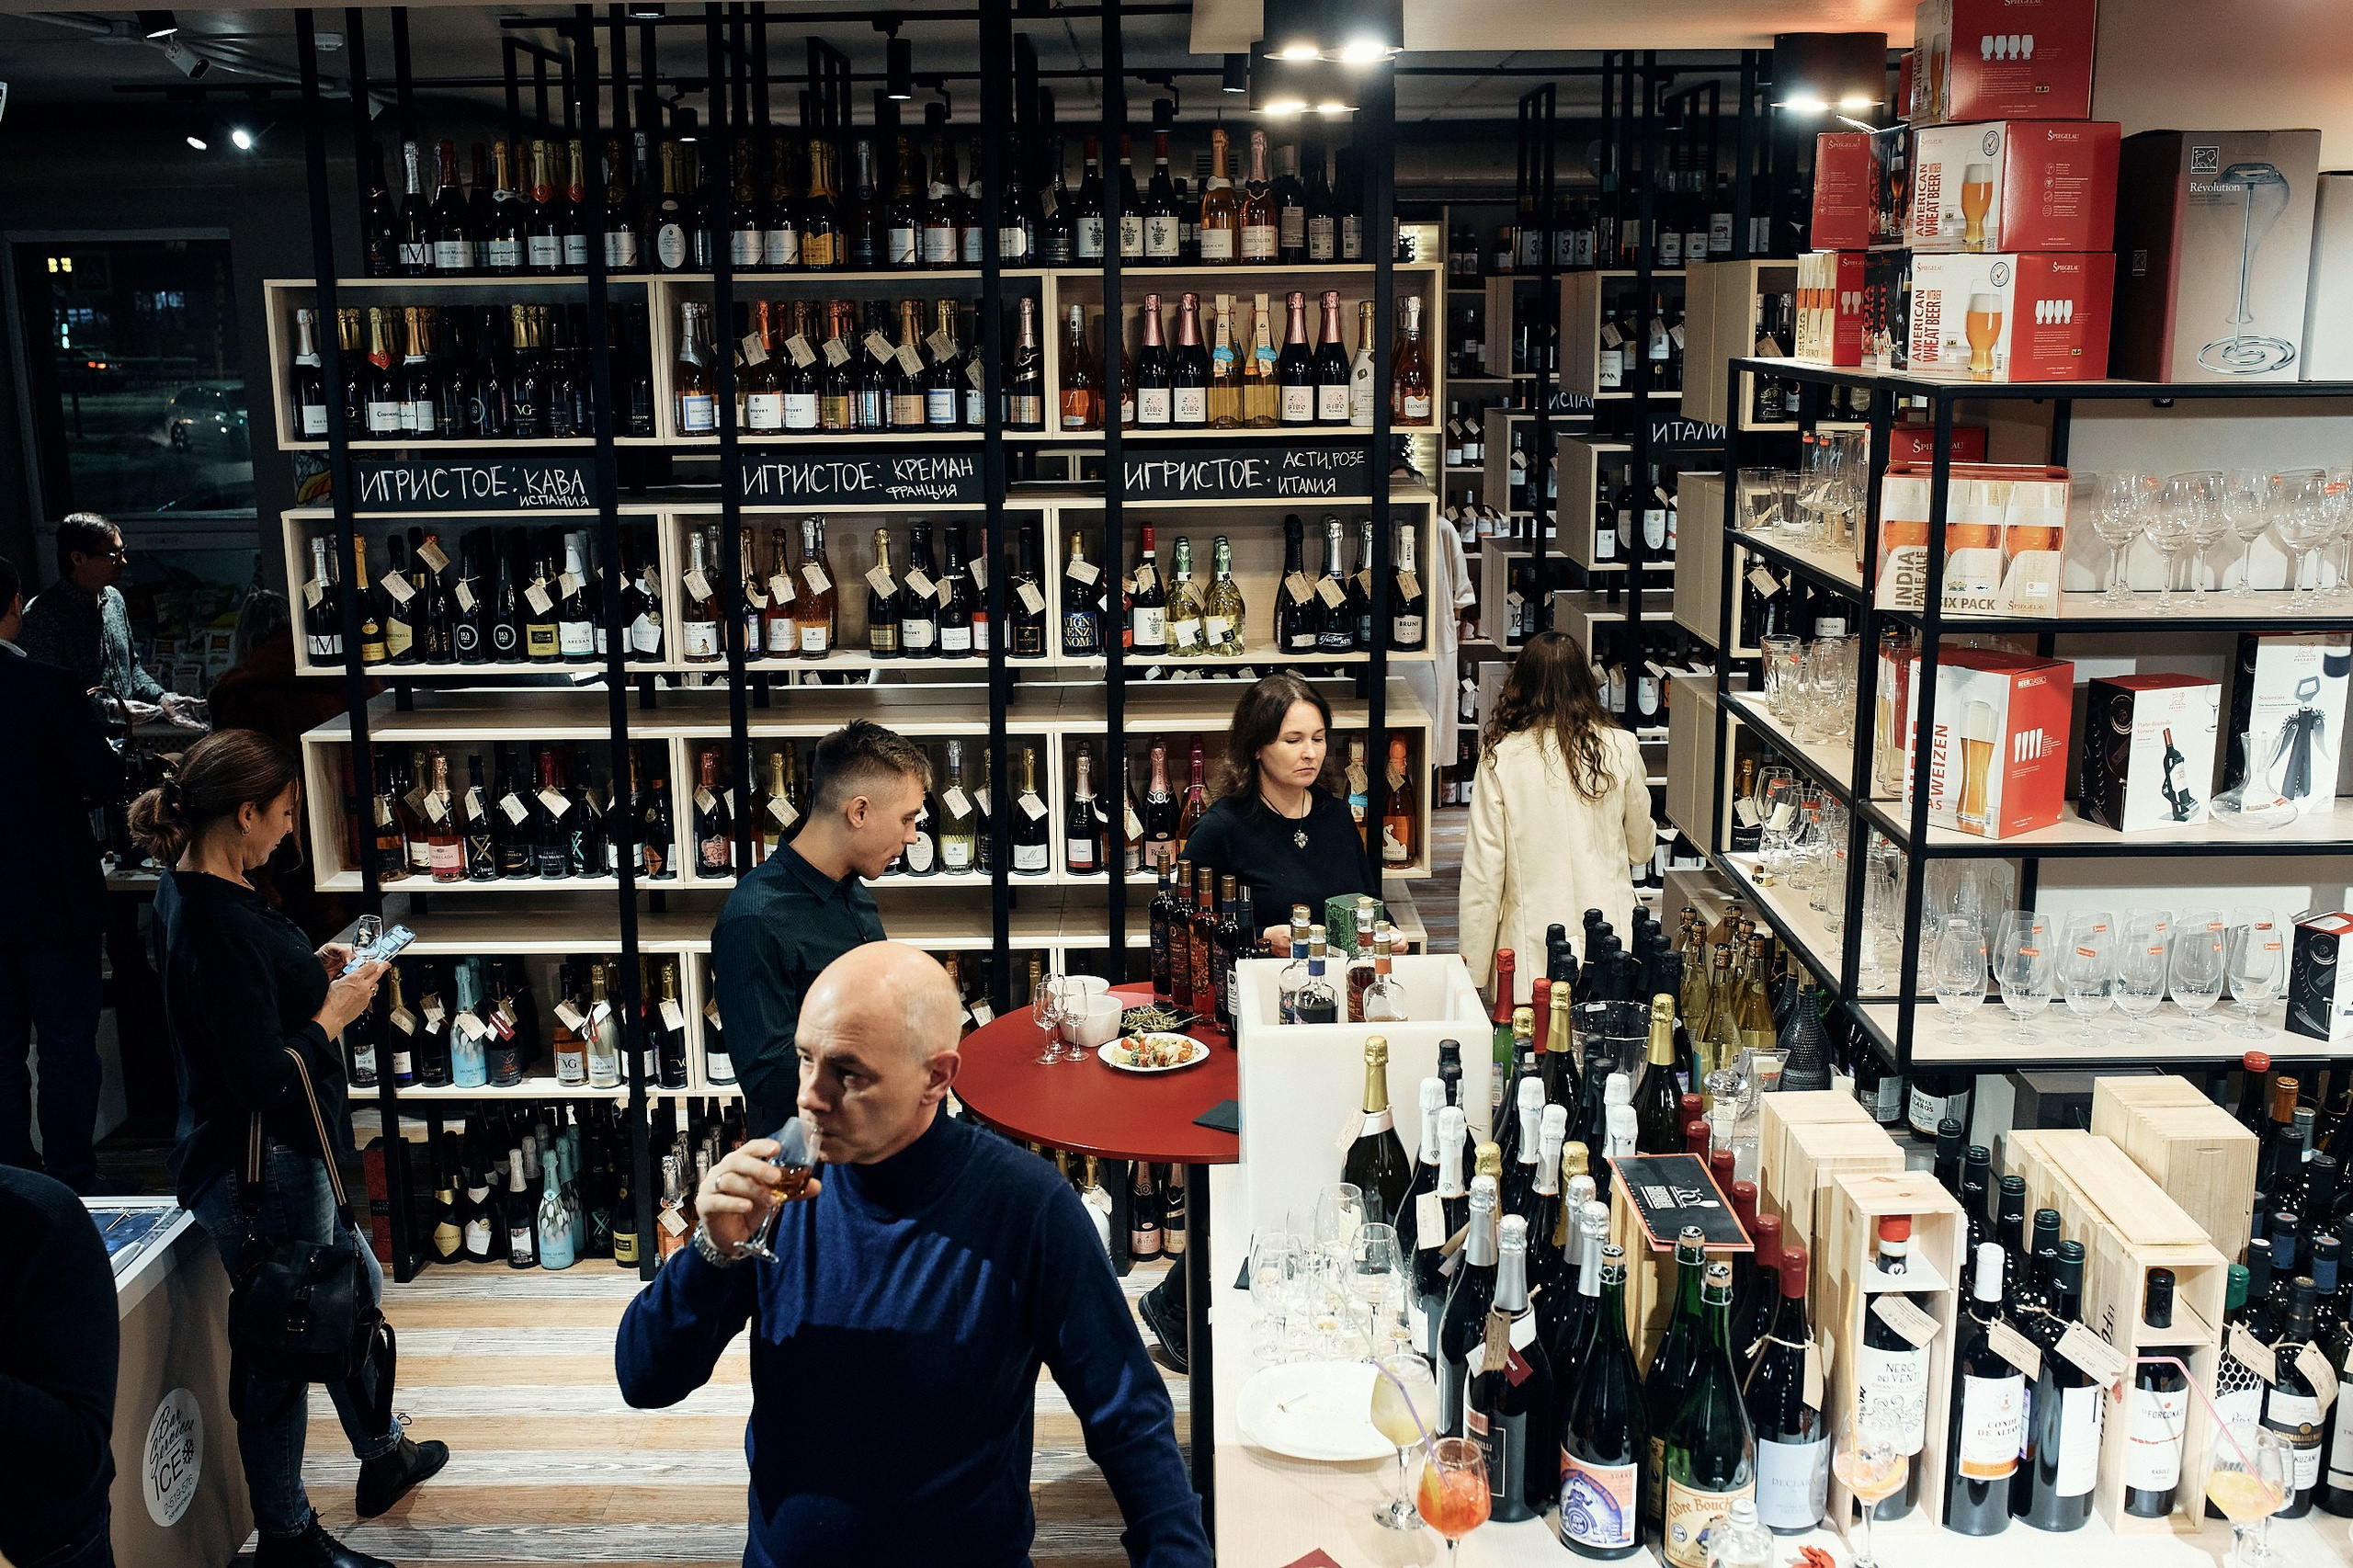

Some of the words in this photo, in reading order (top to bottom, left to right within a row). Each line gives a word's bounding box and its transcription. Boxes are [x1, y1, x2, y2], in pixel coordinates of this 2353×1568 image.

[1927, 174, 1941, 199] BEER
[2189, 181, 2241, 192] Révolution
[1915, 164, 1927, 236] AMERICAN
[1925, 201, 1938, 236] WHEAT
[1916, 262, 1944, 272] SPIEGELAU
[1878, 283, 1887, 356] STOUT
[1926, 301, 1941, 325] BEER
[1912, 290, 1925, 361] AMERICAN
[1923, 327, 1939, 362] WHEAT
[1549, 392, 1594, 410] ИСПА
[359, 465, 518, 502] ИГРИСТОЕ:
[523, 469, 586, 495] КАВА
[742, 462, 883, 495] ИГРИСТОЕ:
[892, 457, 973, 482] КРЕМАН
[1124, 459, 1271, 492] ИГРИСТОЕ:
[1278, 475, 1336, 494] ИТАЛИЯ
[519, 494, 589, 507] ИСПАНИЯ
[885, 483, 958, 500] ФРАНЦИЯ
[1916, 551, 1927, 574] ALE
[1894, 551, 1915, 606] INDIA
[1913, 578, 1927, 607] PALE
[1961, 598, 1995, 610] PACK
[2007, 599, 2046, 611] SPIEGELAU
[1511, 613, 1522, 628] 12
[1226, 631, 1233, 642] 3
[1930, 724, 1948, 796] WEIZEN
[1908, 794, 1943, 811] GAS
[1912, 1097, 1934, 1112] CLAROS
[1886, 1362, 1916, 1373] NERO
[1892, 1372, 1920, 1383] VENTI
[154, 1448, 184, 1501] ICE
[1667, 1500, 1693, 1517] Cidre
